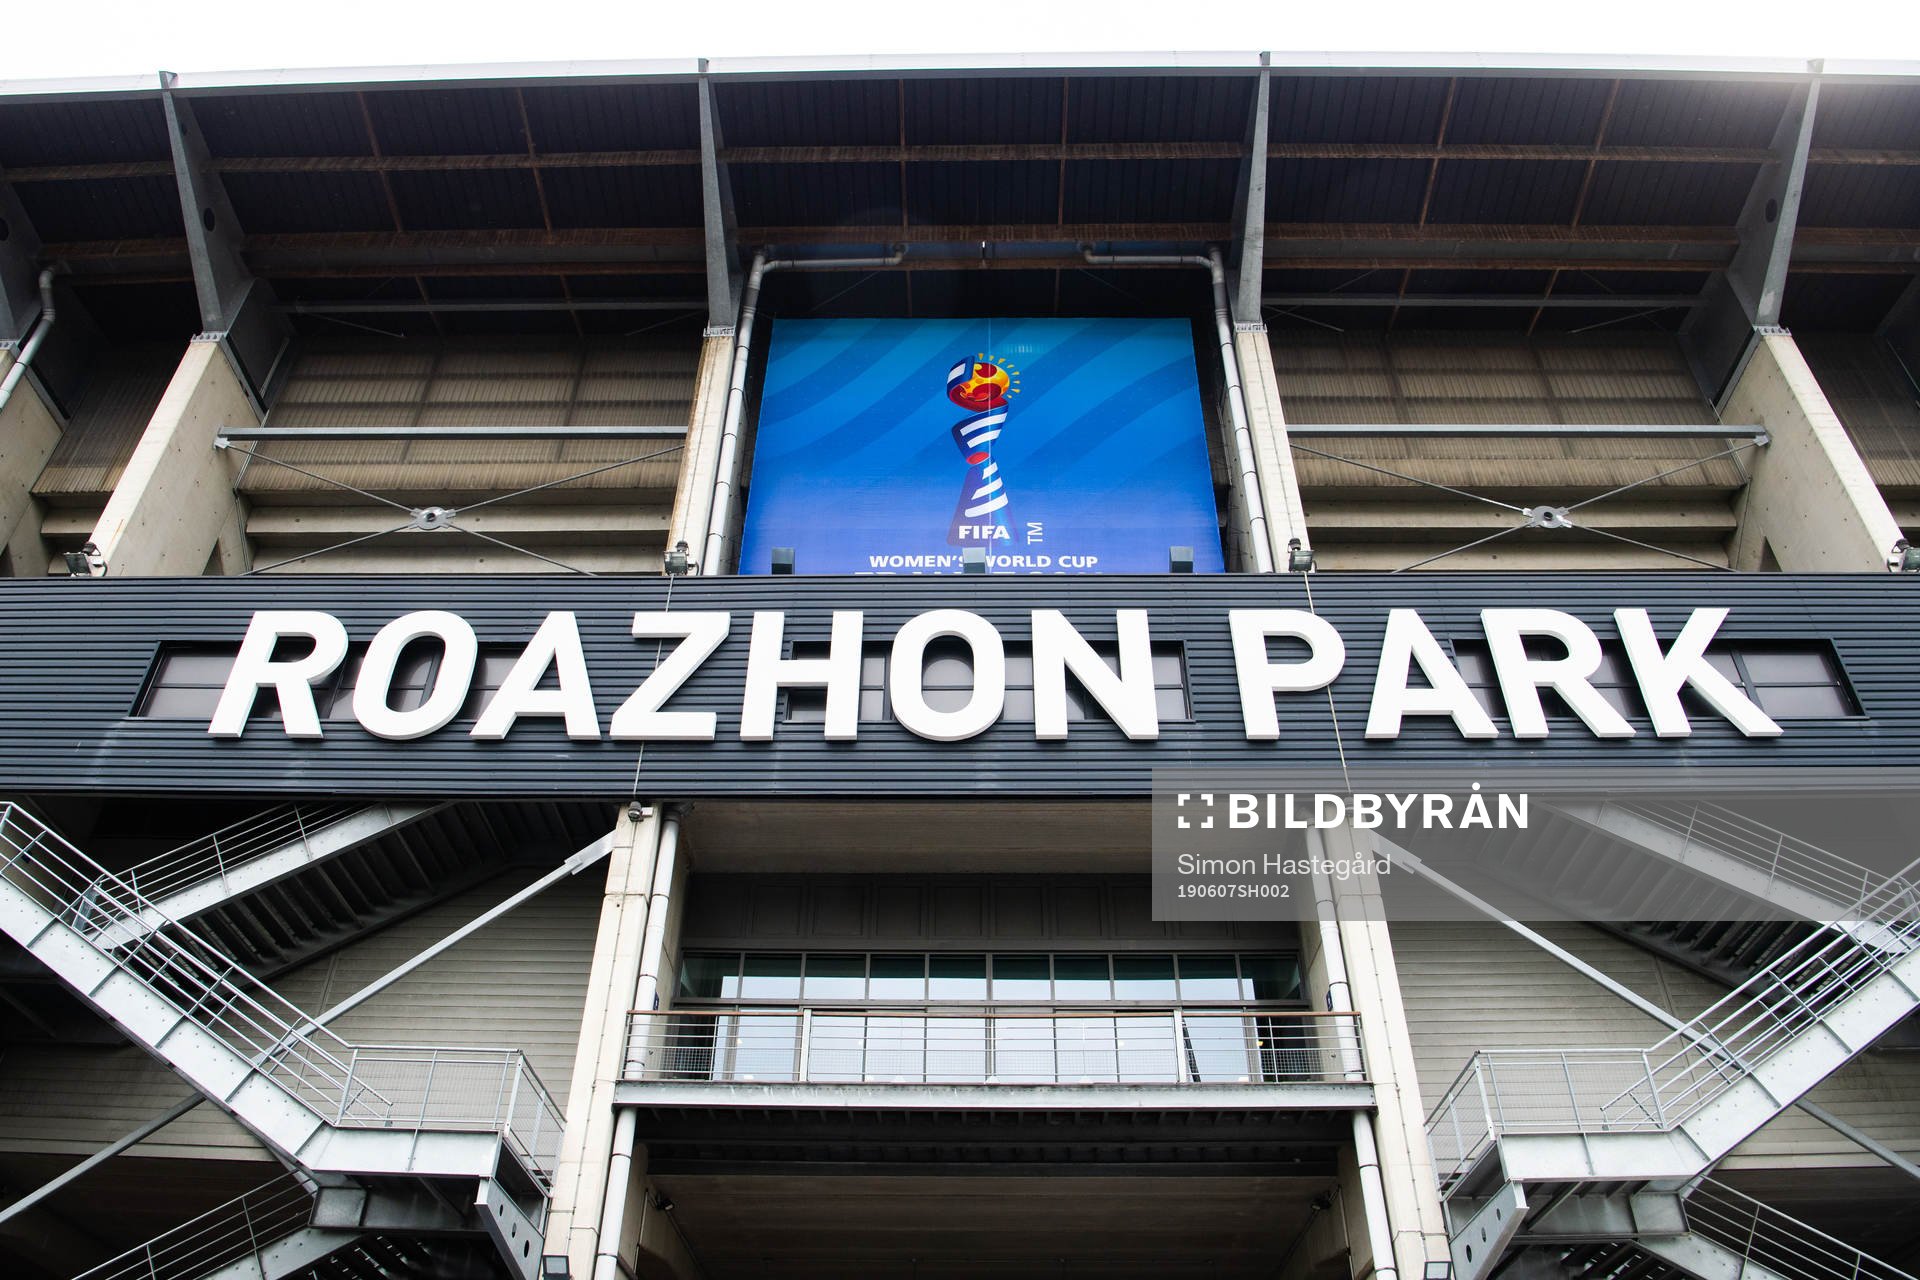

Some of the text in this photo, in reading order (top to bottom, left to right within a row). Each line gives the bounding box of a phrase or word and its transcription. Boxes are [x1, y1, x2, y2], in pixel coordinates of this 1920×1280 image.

[958, 525, 1011, 540] FIFA
[1027, 522, 1043, 545] TM
[1058, 554, 1099, 568] CUP
[207, 607, 1784, 743] ROAZHON PARK
